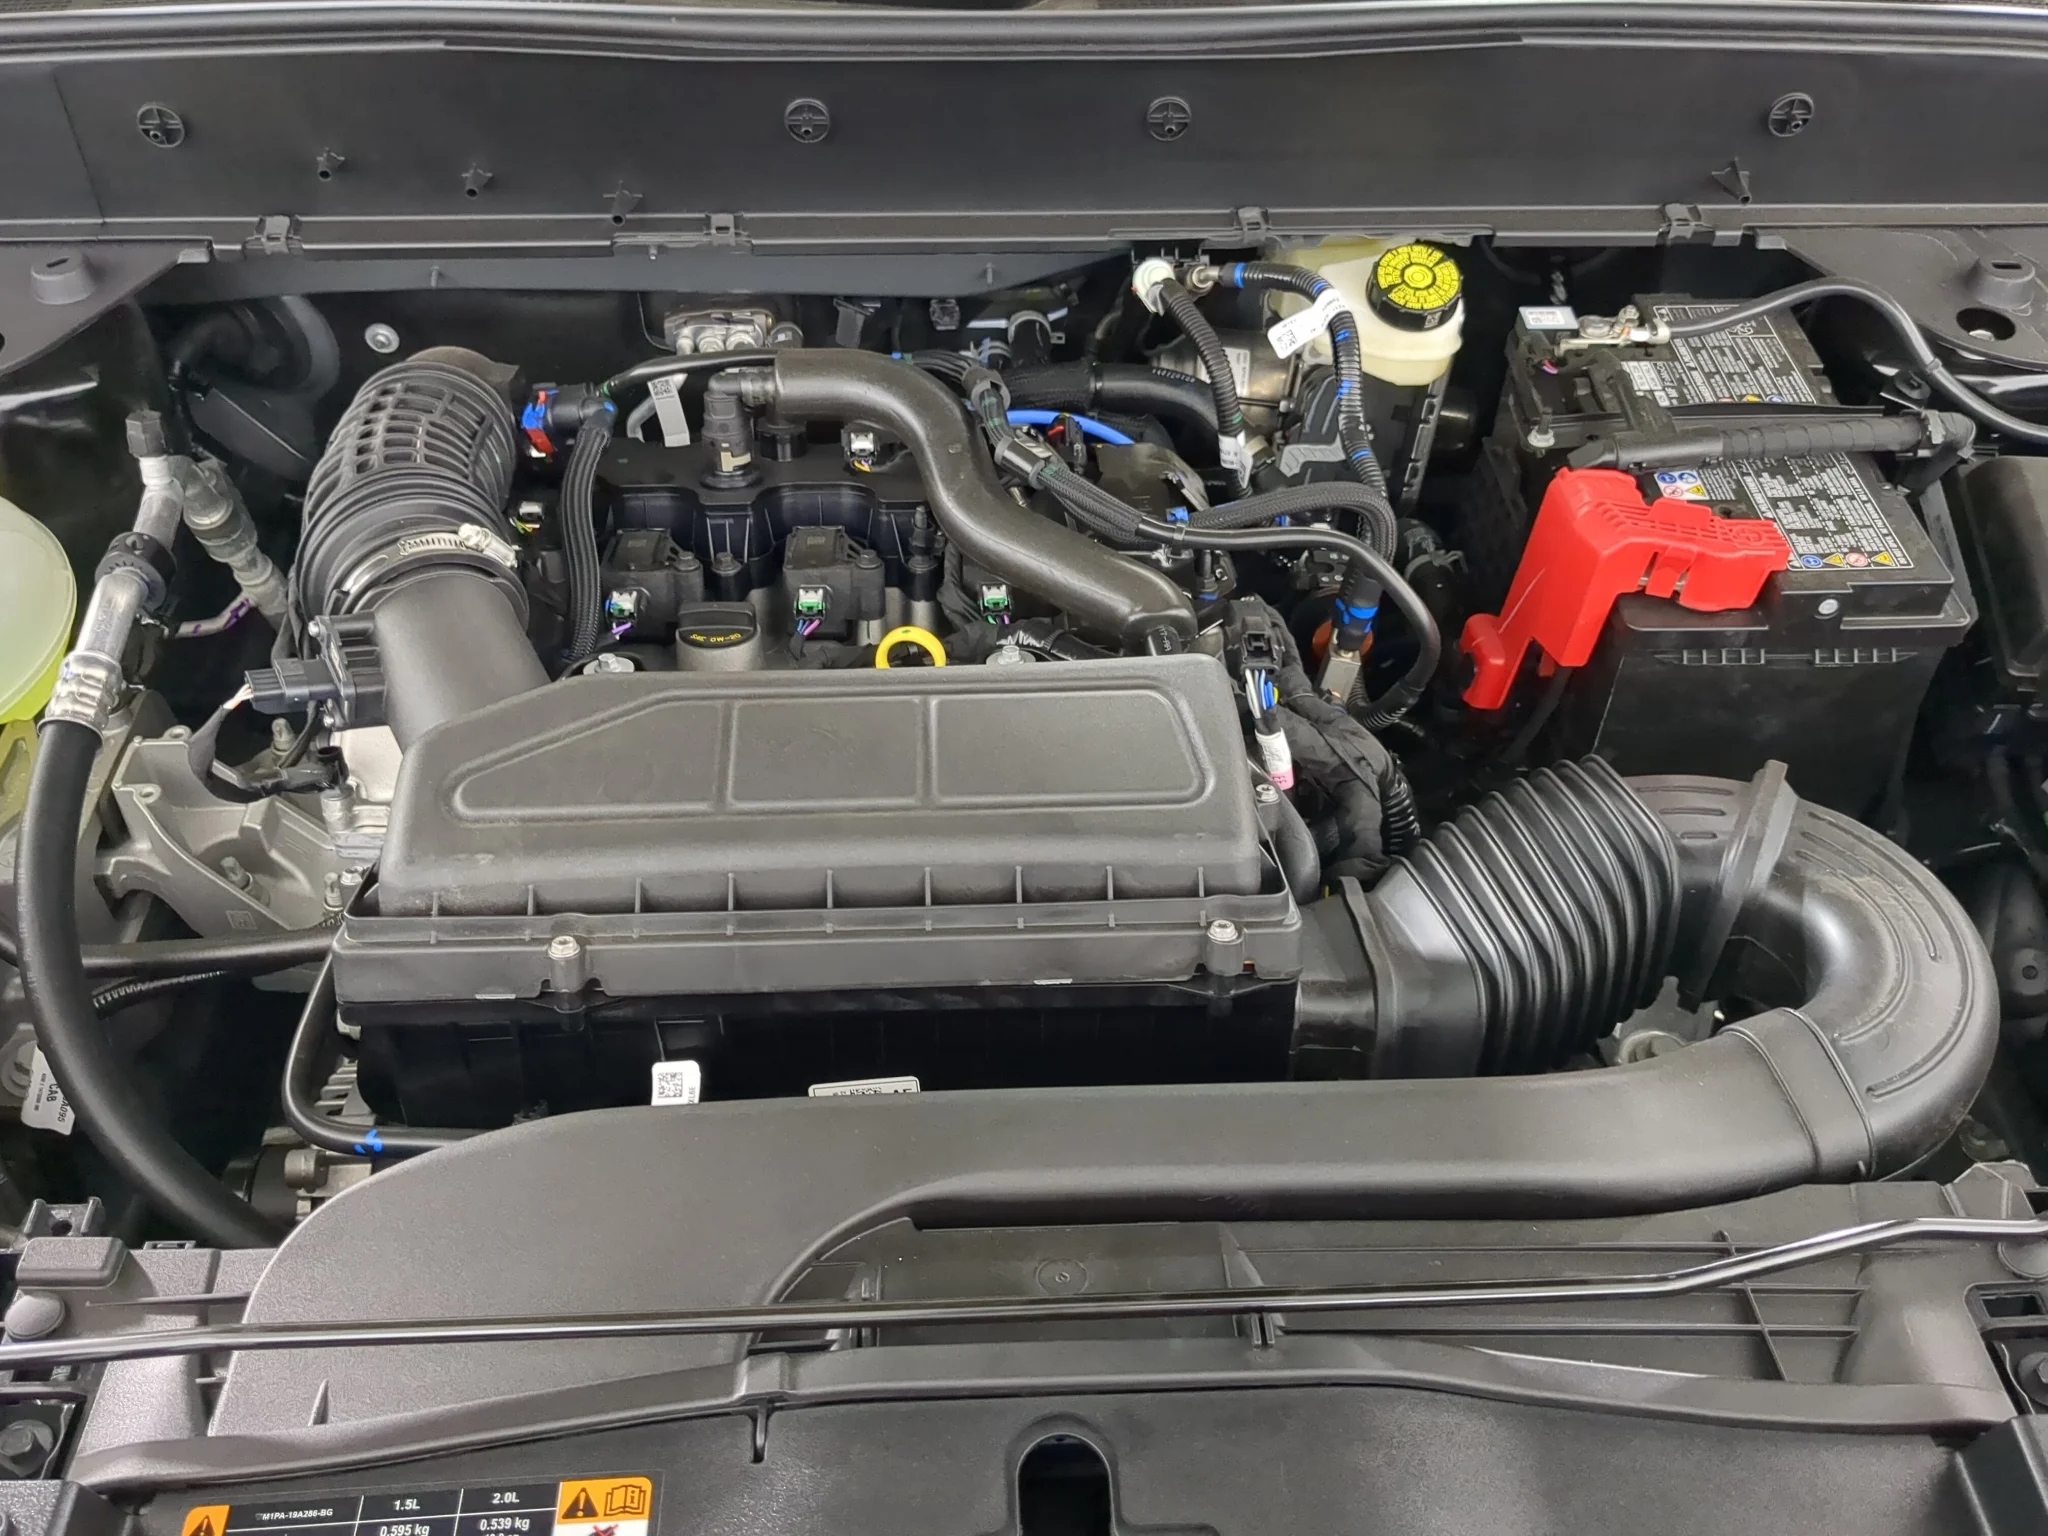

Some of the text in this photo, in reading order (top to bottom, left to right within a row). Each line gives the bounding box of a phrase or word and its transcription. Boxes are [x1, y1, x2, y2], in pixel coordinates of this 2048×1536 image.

[46, 1083, 60, 1102] CAB
[492, 1491, 520, 1504] 2.0L
[393, 1498, 421, 1511] 1.5L
[379, 1523, 430, 1536] 0.595 kg
[479, 1517, 530, 1531] 0.539 kg
